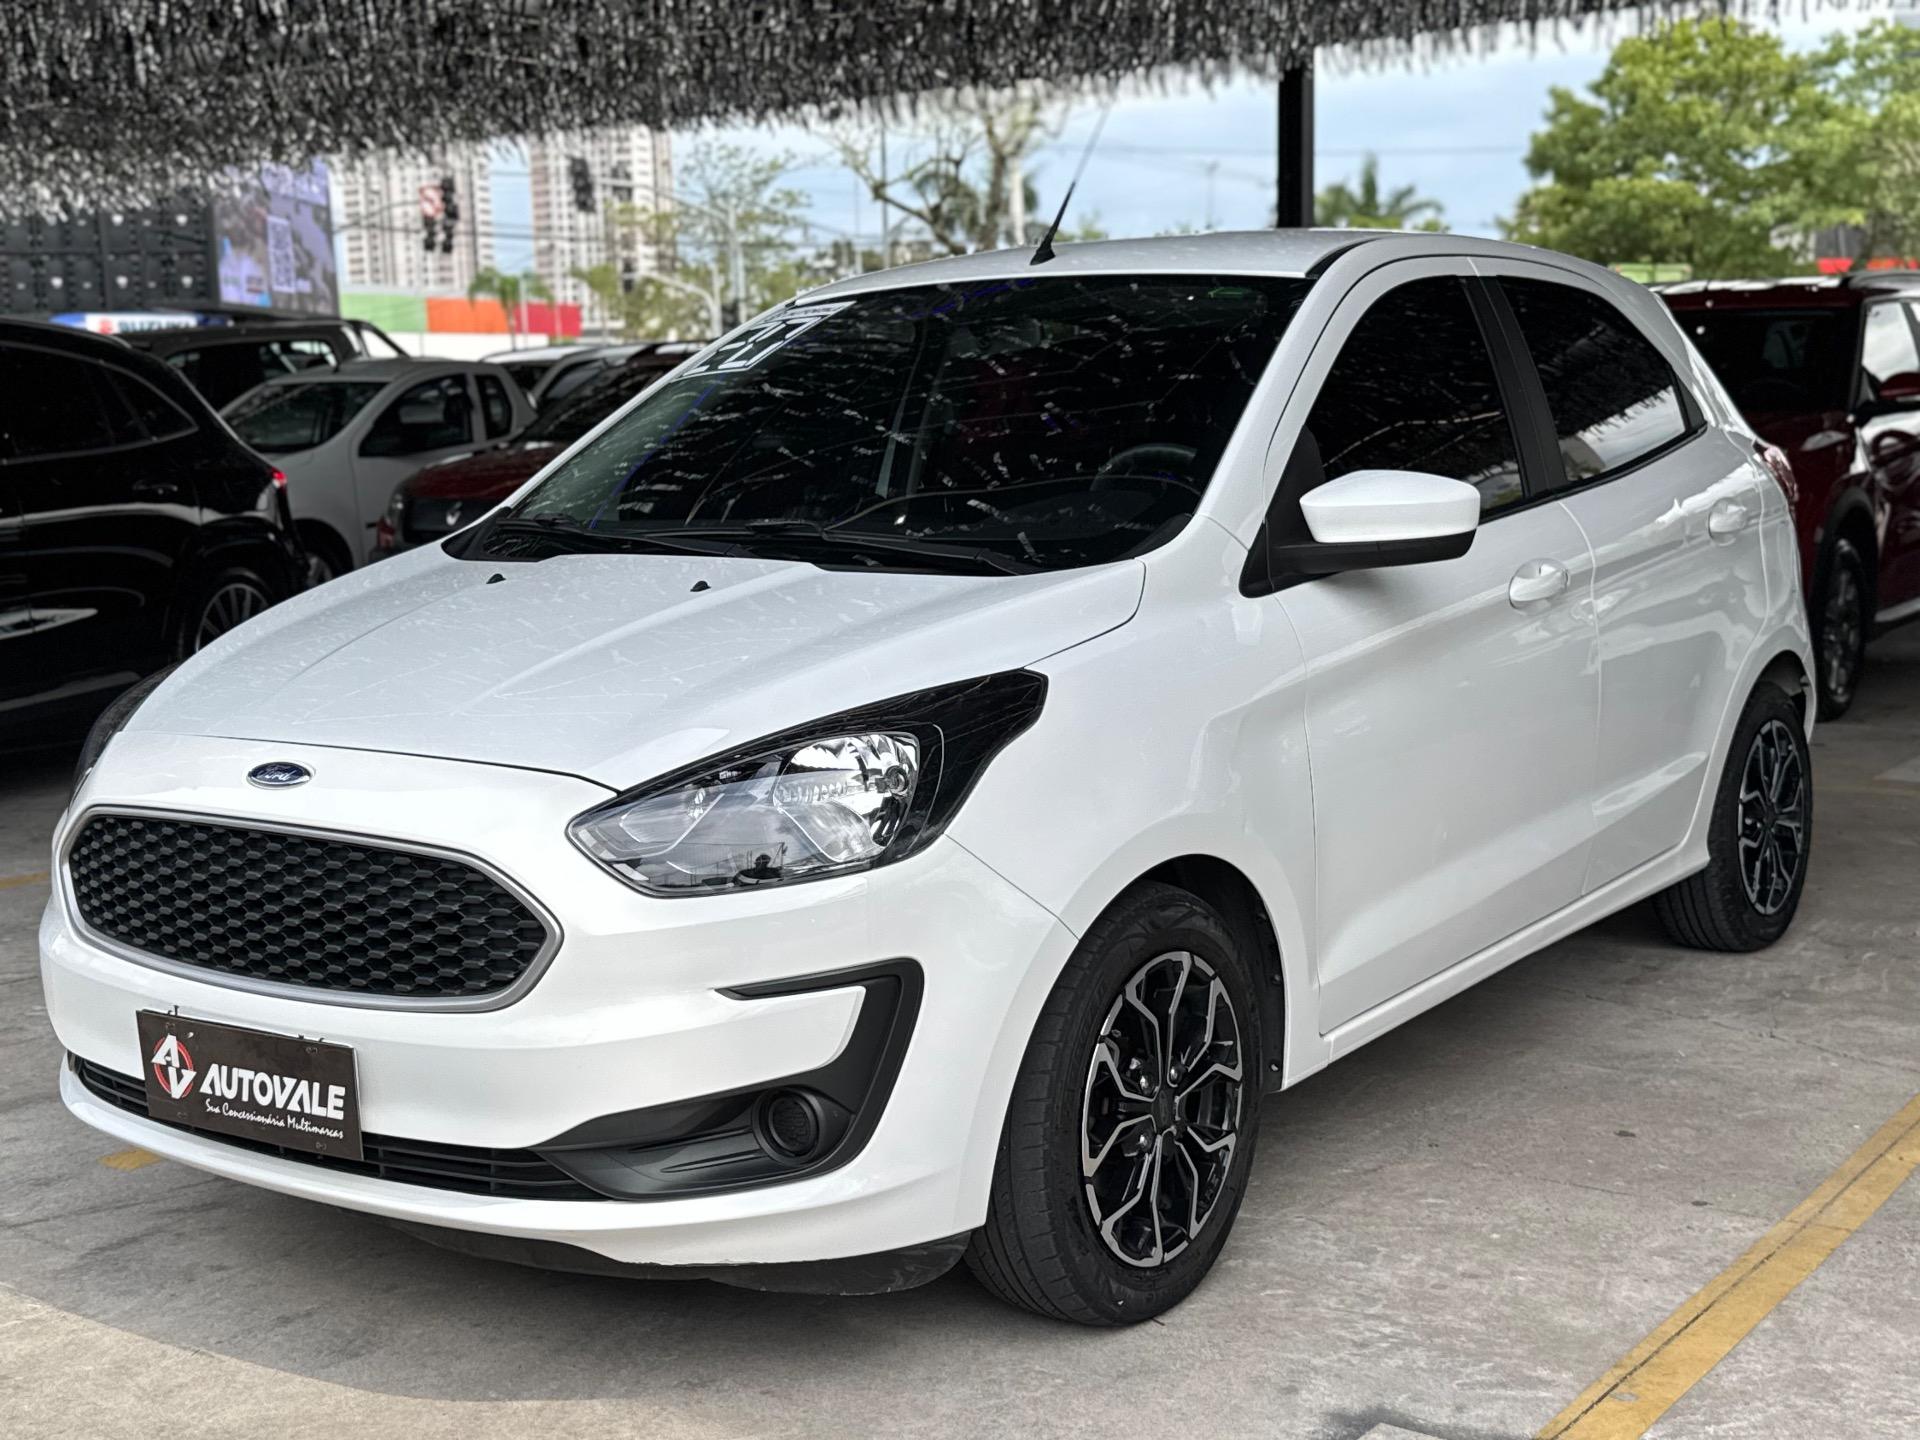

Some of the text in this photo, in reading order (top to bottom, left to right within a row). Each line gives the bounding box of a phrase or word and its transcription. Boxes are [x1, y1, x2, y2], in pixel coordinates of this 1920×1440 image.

[199, 1063, 346, 1120] AUTOVALE
[205, 1098, 220, 1114] Sua
[287, 1115, 344, 1139] Multimarcas
